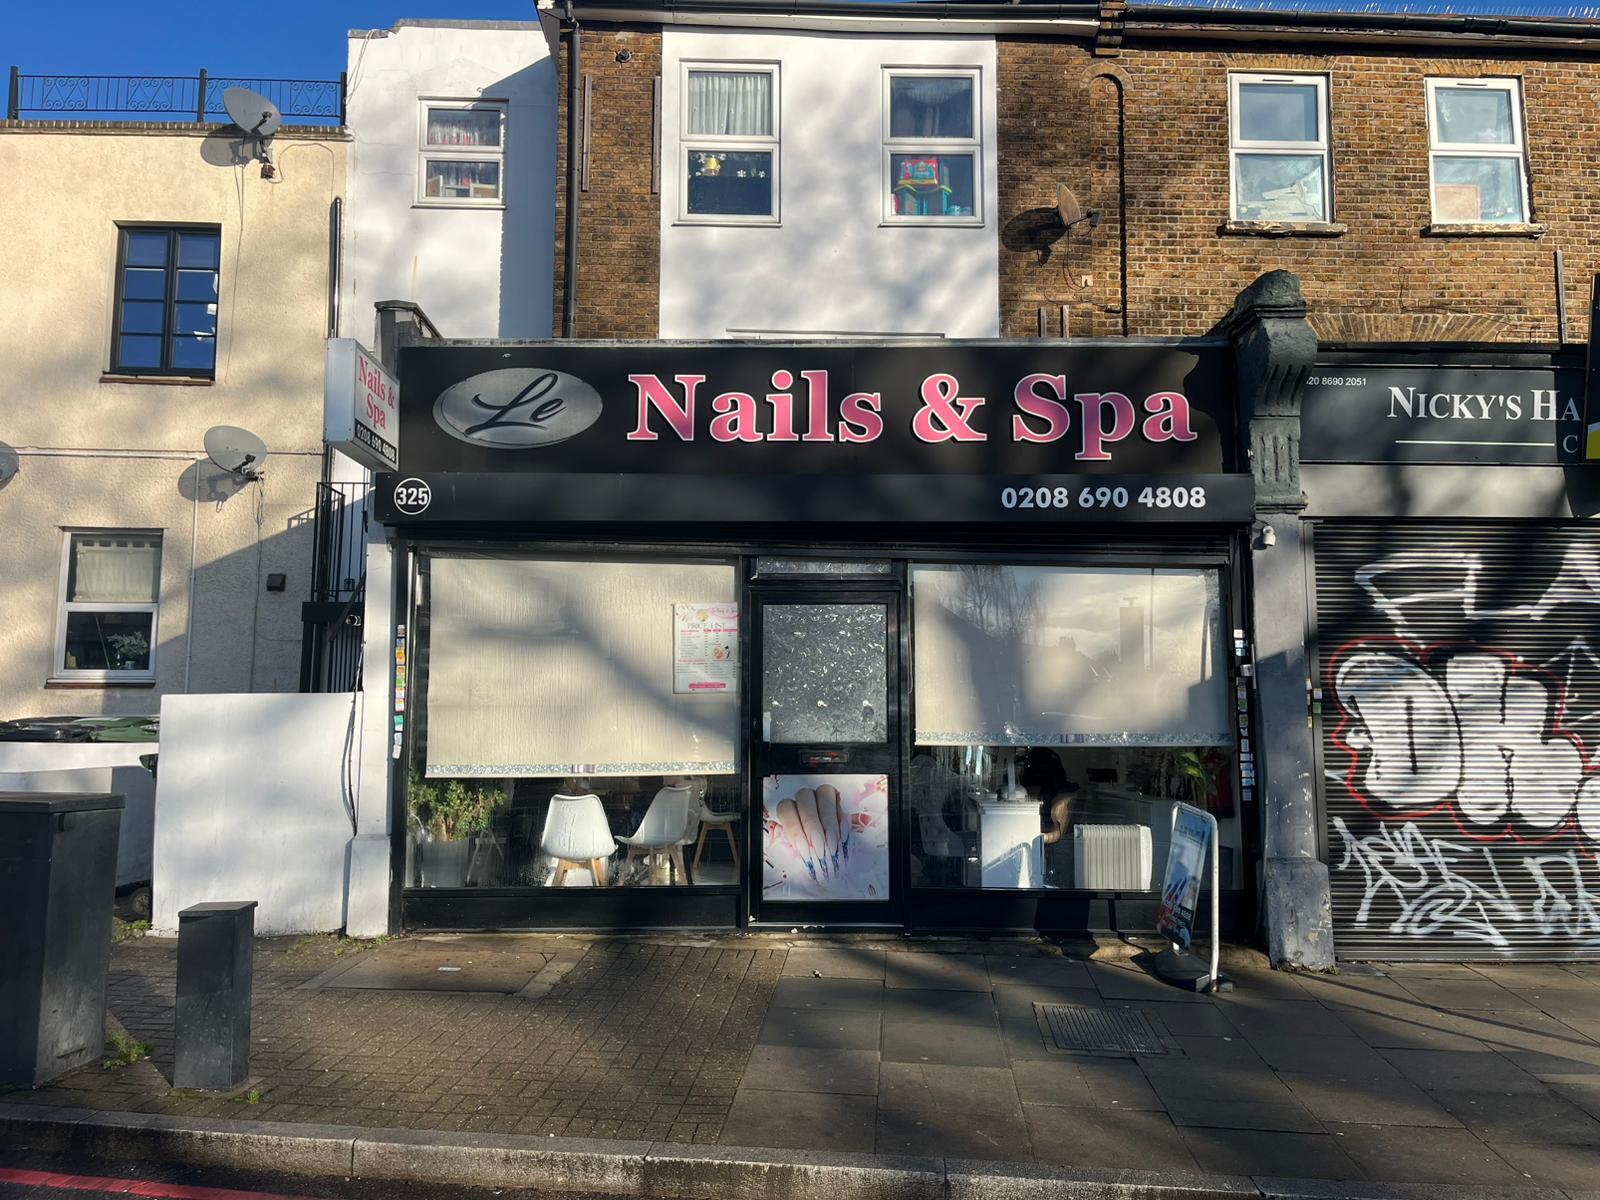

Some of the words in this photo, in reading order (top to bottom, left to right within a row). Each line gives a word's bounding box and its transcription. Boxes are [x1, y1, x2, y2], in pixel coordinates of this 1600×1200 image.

[359, 355, 386, 402] Nails
[387, 386, 396, 410] &
[1321, 376, 1344, 386] 8690
[1345, 377, 1367, 386] 2051
[367, 393, 386, 430] Spa
[464, 372, 566, 438] Le
[626, 369, 884, 443] Nails
[911, 372, 988, 443] &
[1012, 372, 1198, 461] Spa
[1386, 386, 1522, 421] NICKY'S
[396, 487, 429, 506] 325
[1001, 486, 1069, 509] 0208
[1077, 486, 1129, 508] 690
[1137, 486, 1206, 508] 4808
